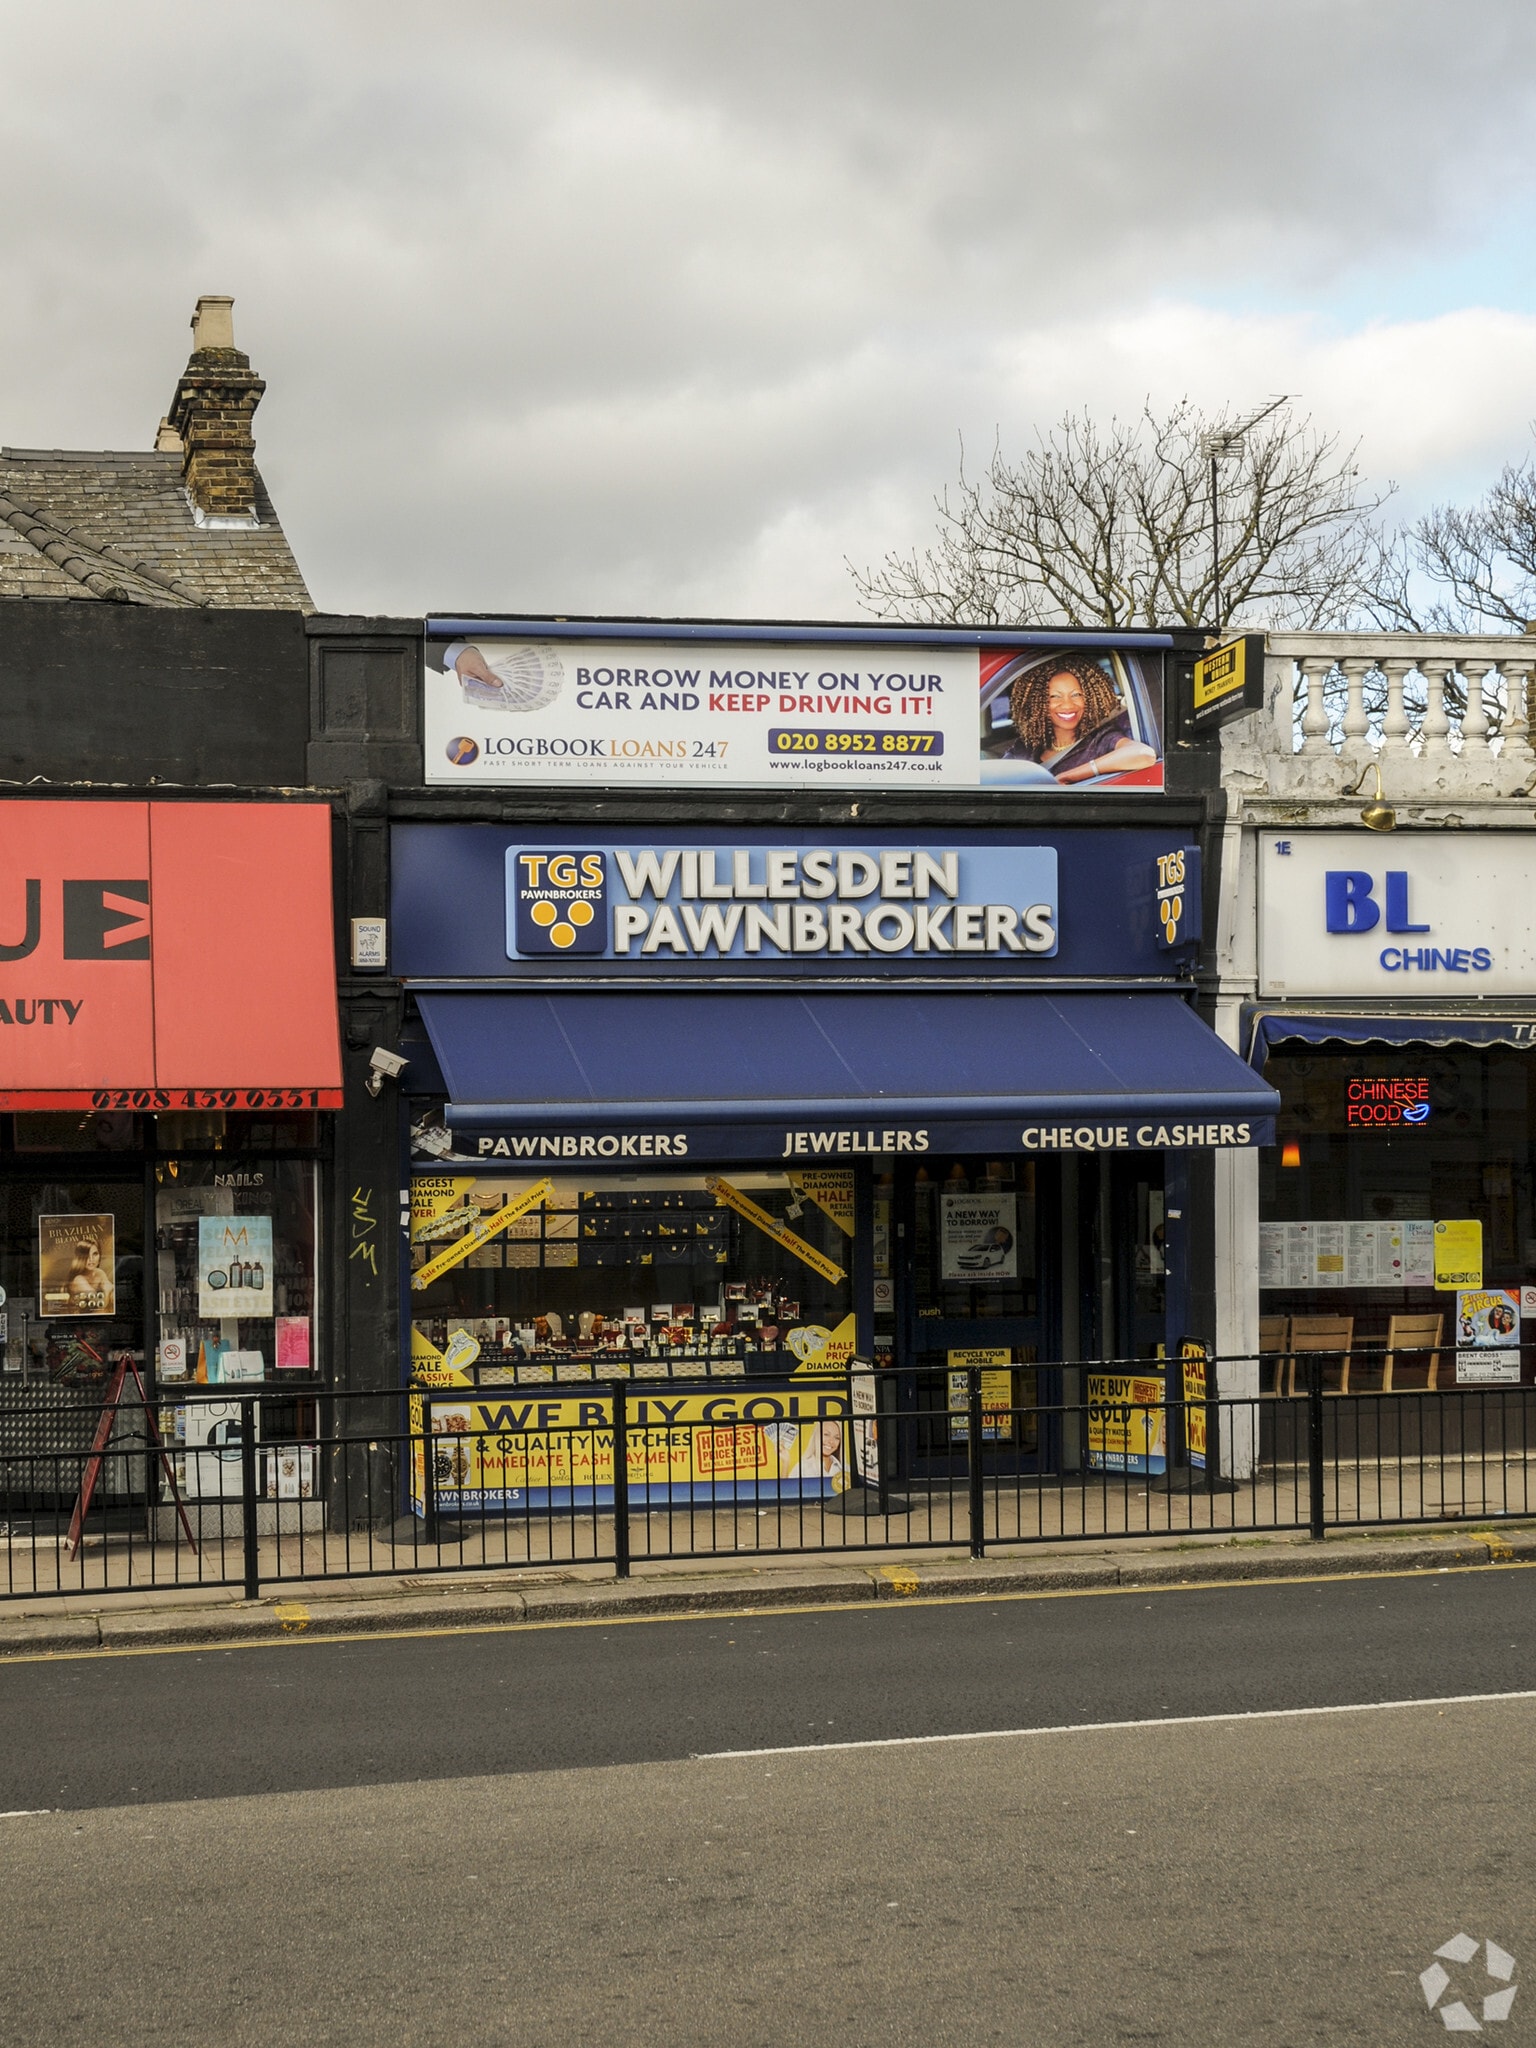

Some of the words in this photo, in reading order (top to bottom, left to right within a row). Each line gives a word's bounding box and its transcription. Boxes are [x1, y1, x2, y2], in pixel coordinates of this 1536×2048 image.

[576, 668, 701, 688] BORROW
[709, 670, 810, 690] MONEY
[817, 672, 859, 691] ON
[867, 673, 944, 692] YOUR
[576, 691, 633, 710] CAR
[640, 692, 700, 711] AND
[709, 693, 770, 712] KEEP
[779, 695, 892, 714] DRIVING
[901, 697, 933, 715] IT!
[484, 738, 607, 757] LOGBOOK
[610, 740, 687, 758] LOANS
[692, 740, 729, 759] 247
[777, 733, 819, 751] 020
[825, 734, 877, 752] 8952
[882, 735, 935, 753] 8877
[769, 759, 943, 772] www.logbookloans247.co.uk
[1275, 841, 1291, 855] 1E
[520, 855, 604, 888] TGS
[614, 850, 959, 899] WILLESDEN
[1157, 850, 1185, 887] TGS
[521, 890, 602, 899] PAWNBROKERS
[1325, 871, 1431, 934] BL
[614, 903, 1056, 953] PAWNBROKERS
[1380, 948, 1492, 973] CHINES
[92, 1090, 170, 1108] 0208
[1348, 1083, 1429, 1100] CHINESE
[1348, 1104, 1401, 1121] FOOD
[478, 1134, 688, 1157] PAWNBROKERS
[782, 1129, 929, 1158] JEWELLERS
[1021, 1126, 1129, 1151] CHEQUE
[1136, 1124, 1251, 1147] CASHERS
[214, 1172, 264, 1187] NAILS
[802, 1172, 853, 1180] PRE-OWNED
[803, 1181, 853, 1189] DIAMONDS
[817, 1191, 853, 1202] HALF
[946, 1211, 953, 1219] A
[978, 1210, 1000, 1218] WAY
[49, 1224, 105, 1239] BRAZILIAN
[421, 1267, 437, 1280] Sale
[436, 1246, 465, 1270] Pre-owned
[489, 1217, 505, 1230] Half
[504, 1210, 515, 1220] The
[515, 1198, 531, 1212] Retail
[531, 1189, 545, 1200] Price
[716, 1184, 731, 1198] Sale
[730, 1194, 757, 1218] Pre-owned
[781, 1233, 797, 1247] Half
[805, 1251, 821, 1267] Retail
[820, 1262, 834, 1276] Price
[55, 1236, 80, 1245] BLOW
[919, 1307, 941, 1317] push
[1461, 1295, 1503, 1320] CIRCUS
[828, 1342, 854, 1350] HALF
[411, 1361, 441, 1372] SALE
[806, 1362, 847, 1370] DIAMON
[415, 1373, 454, 1382] ASSIVE
[1089, 1378, 1105, 1395] WE
[1108, 1379, 1131, 1397] BUY
[477, 1403, 562, 1430] WE
[702, 1395, 849, 1427] GOLD
[1090, 1399, 1131, 1423] GOLD
[702, 1430, 760, 1449] HGHEST
[1093, 1427, 1111, 1435] QUAITY
[1112, 1429, 1132, 1437] WATCES
[496, 1434, 590, 1453] QUALITY
[740, 1446, 762, 1457] PAID
[476, 1454, 563, 1469] IMMEDIATE
[571, 1453, 610, 1466] CASH
[625, 1450, 688, 1464] AYMENT
[1096, 1452, 1138, 1464] PANBROERS
[433, 1489, 519, 1502] AWNBROKERS
